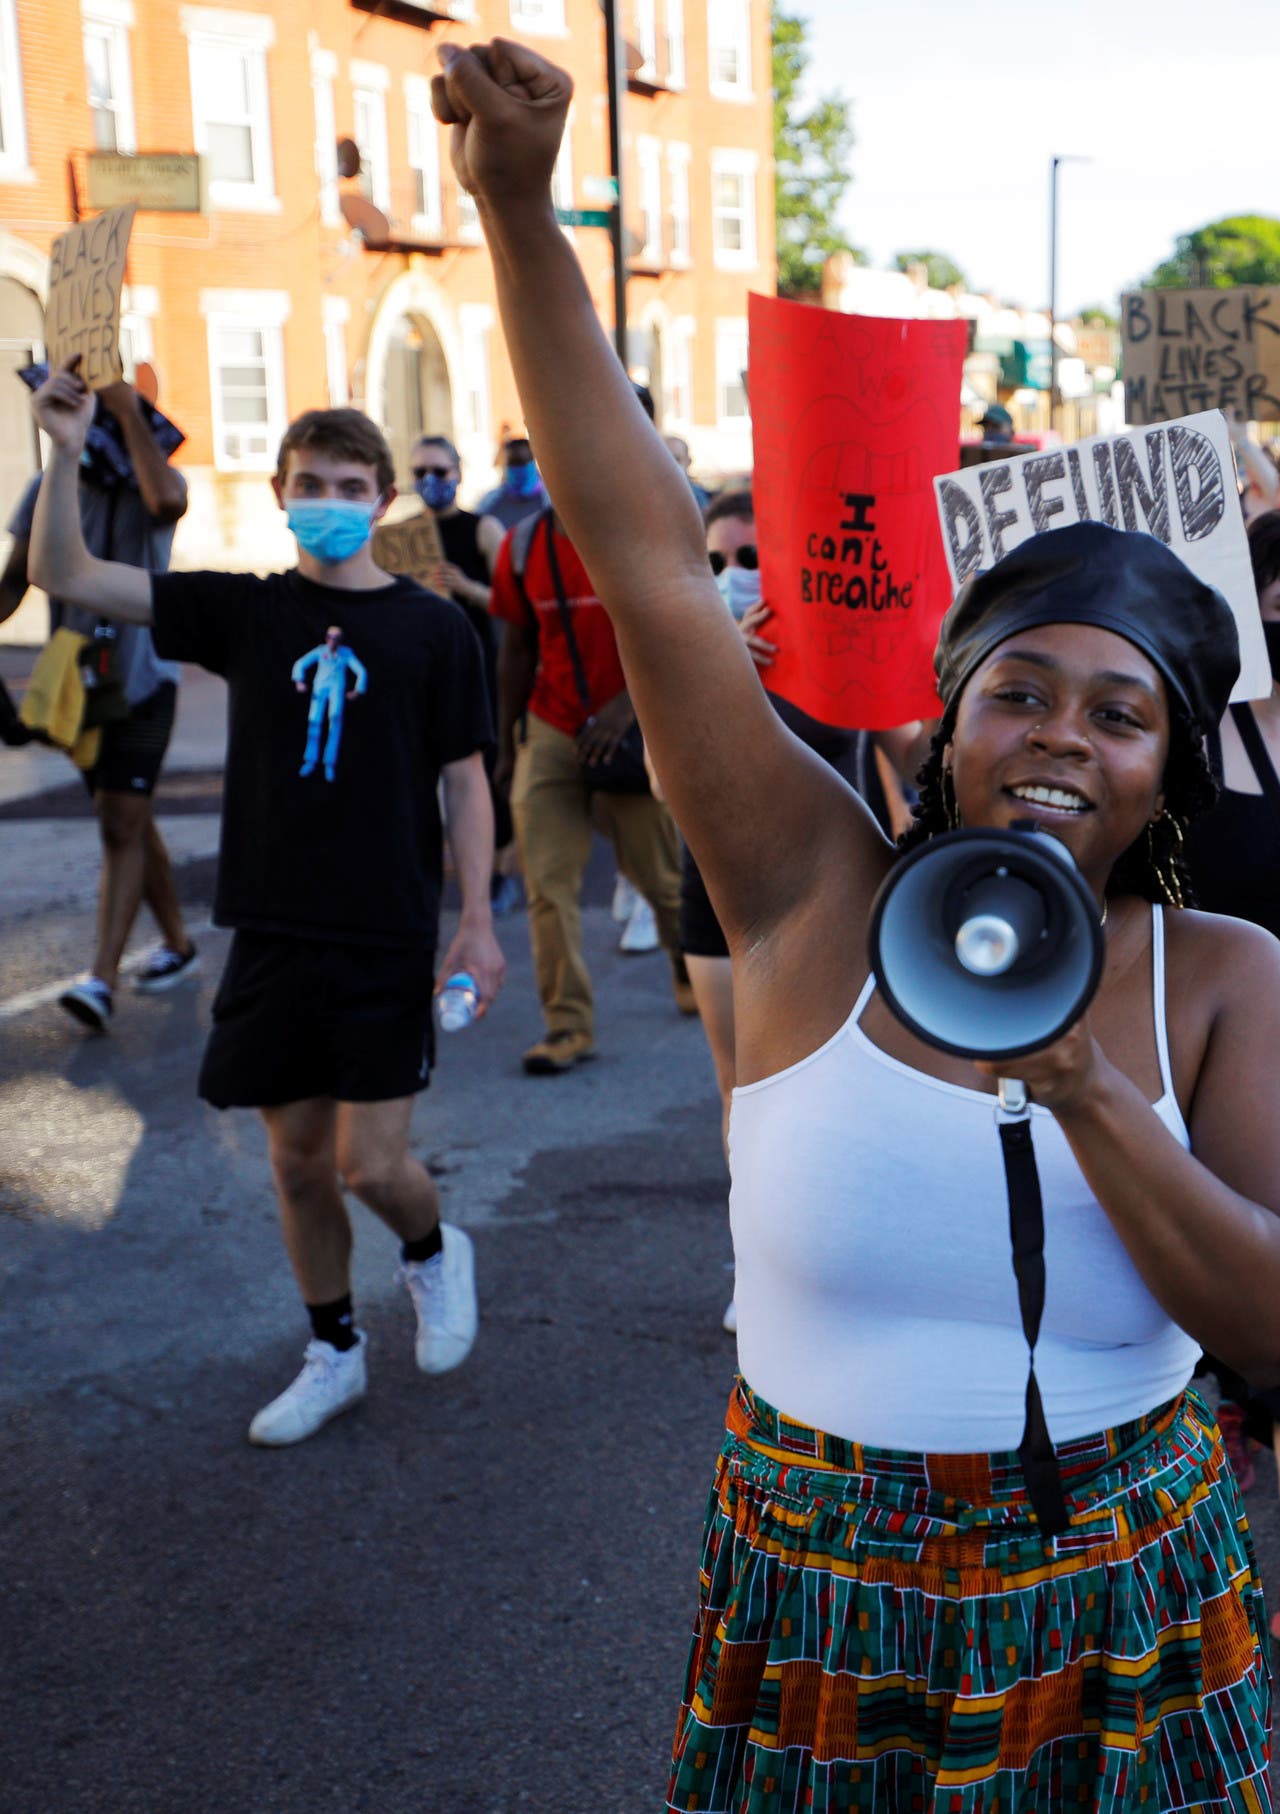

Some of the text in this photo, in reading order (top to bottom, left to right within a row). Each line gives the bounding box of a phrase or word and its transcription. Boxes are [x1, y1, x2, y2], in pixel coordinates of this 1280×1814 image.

[50, 211, 126, 286] BLACK
[56, 260, 118, 336] LIVES
[1160, 344, 1245, 383] LIVES
[939, 425, 1225, 584] DEFUND
